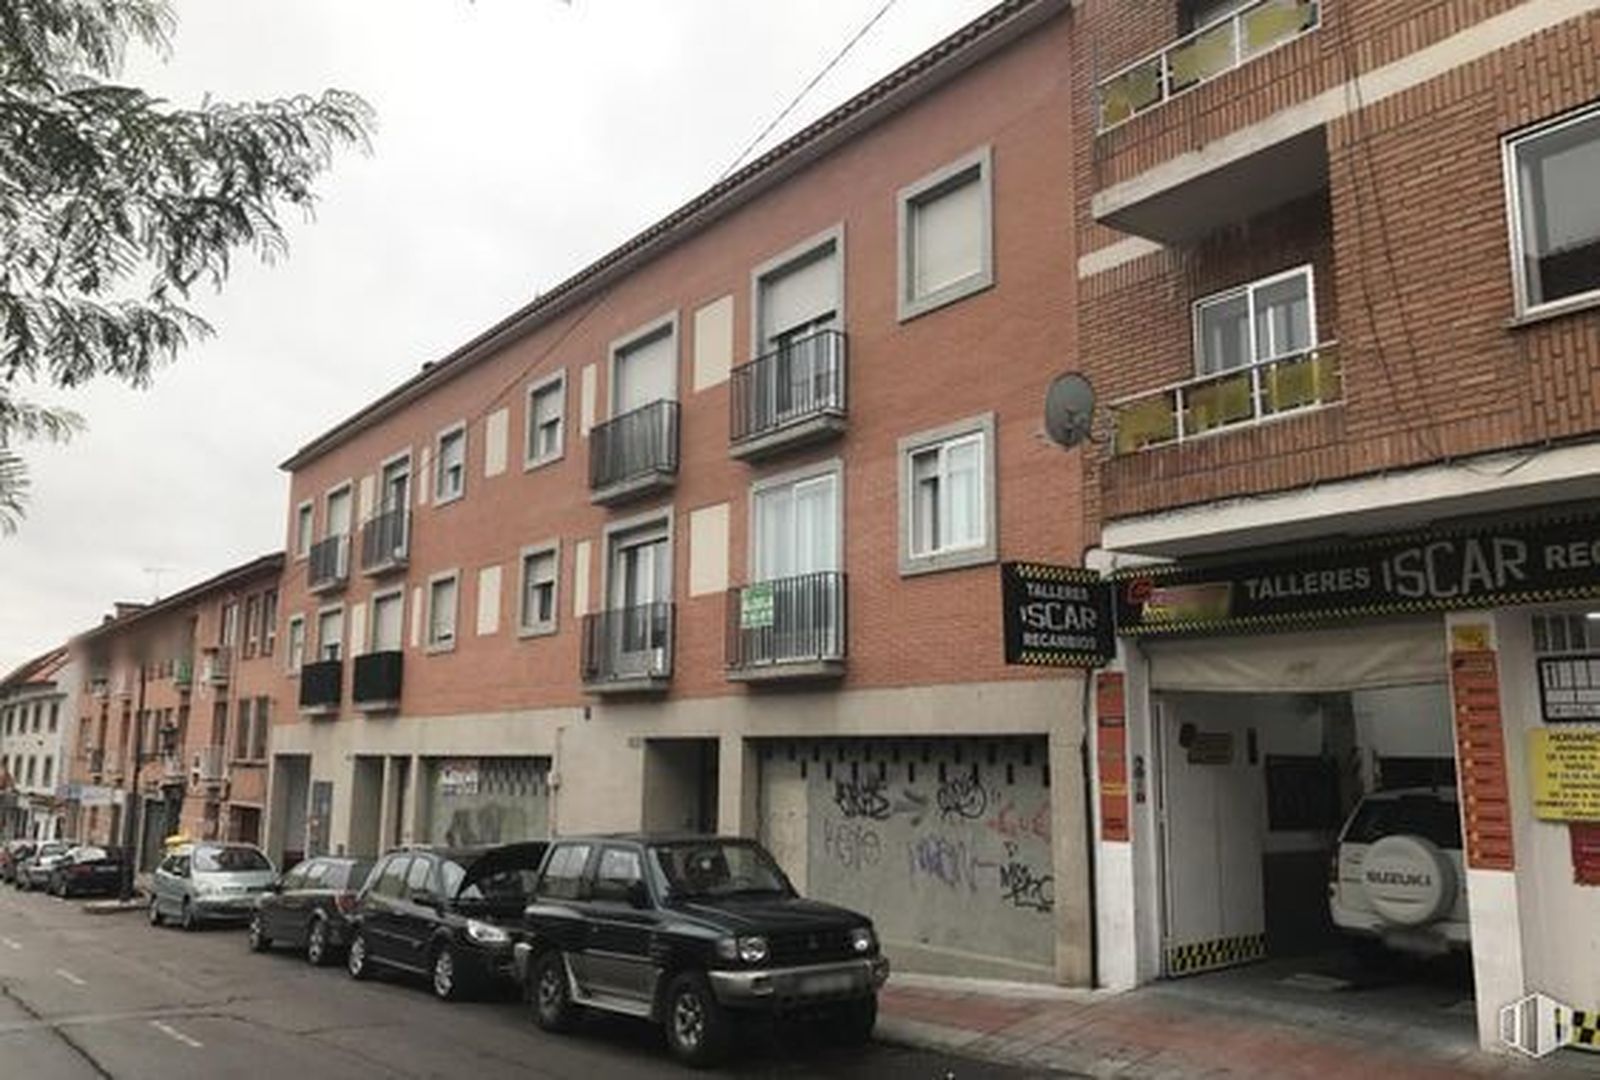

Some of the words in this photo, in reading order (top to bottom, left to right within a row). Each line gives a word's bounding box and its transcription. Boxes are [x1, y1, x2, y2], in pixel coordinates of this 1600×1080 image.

[1246, 567, 1370, 600] TALLERES
[1382, 537, 1528, 599] ISCAR
[1026, 582, 1088, 601] TALLERES
[1020, 601, 1097, 631] ISCAR
[1367, 871, 1431, 887] SUZUKI
